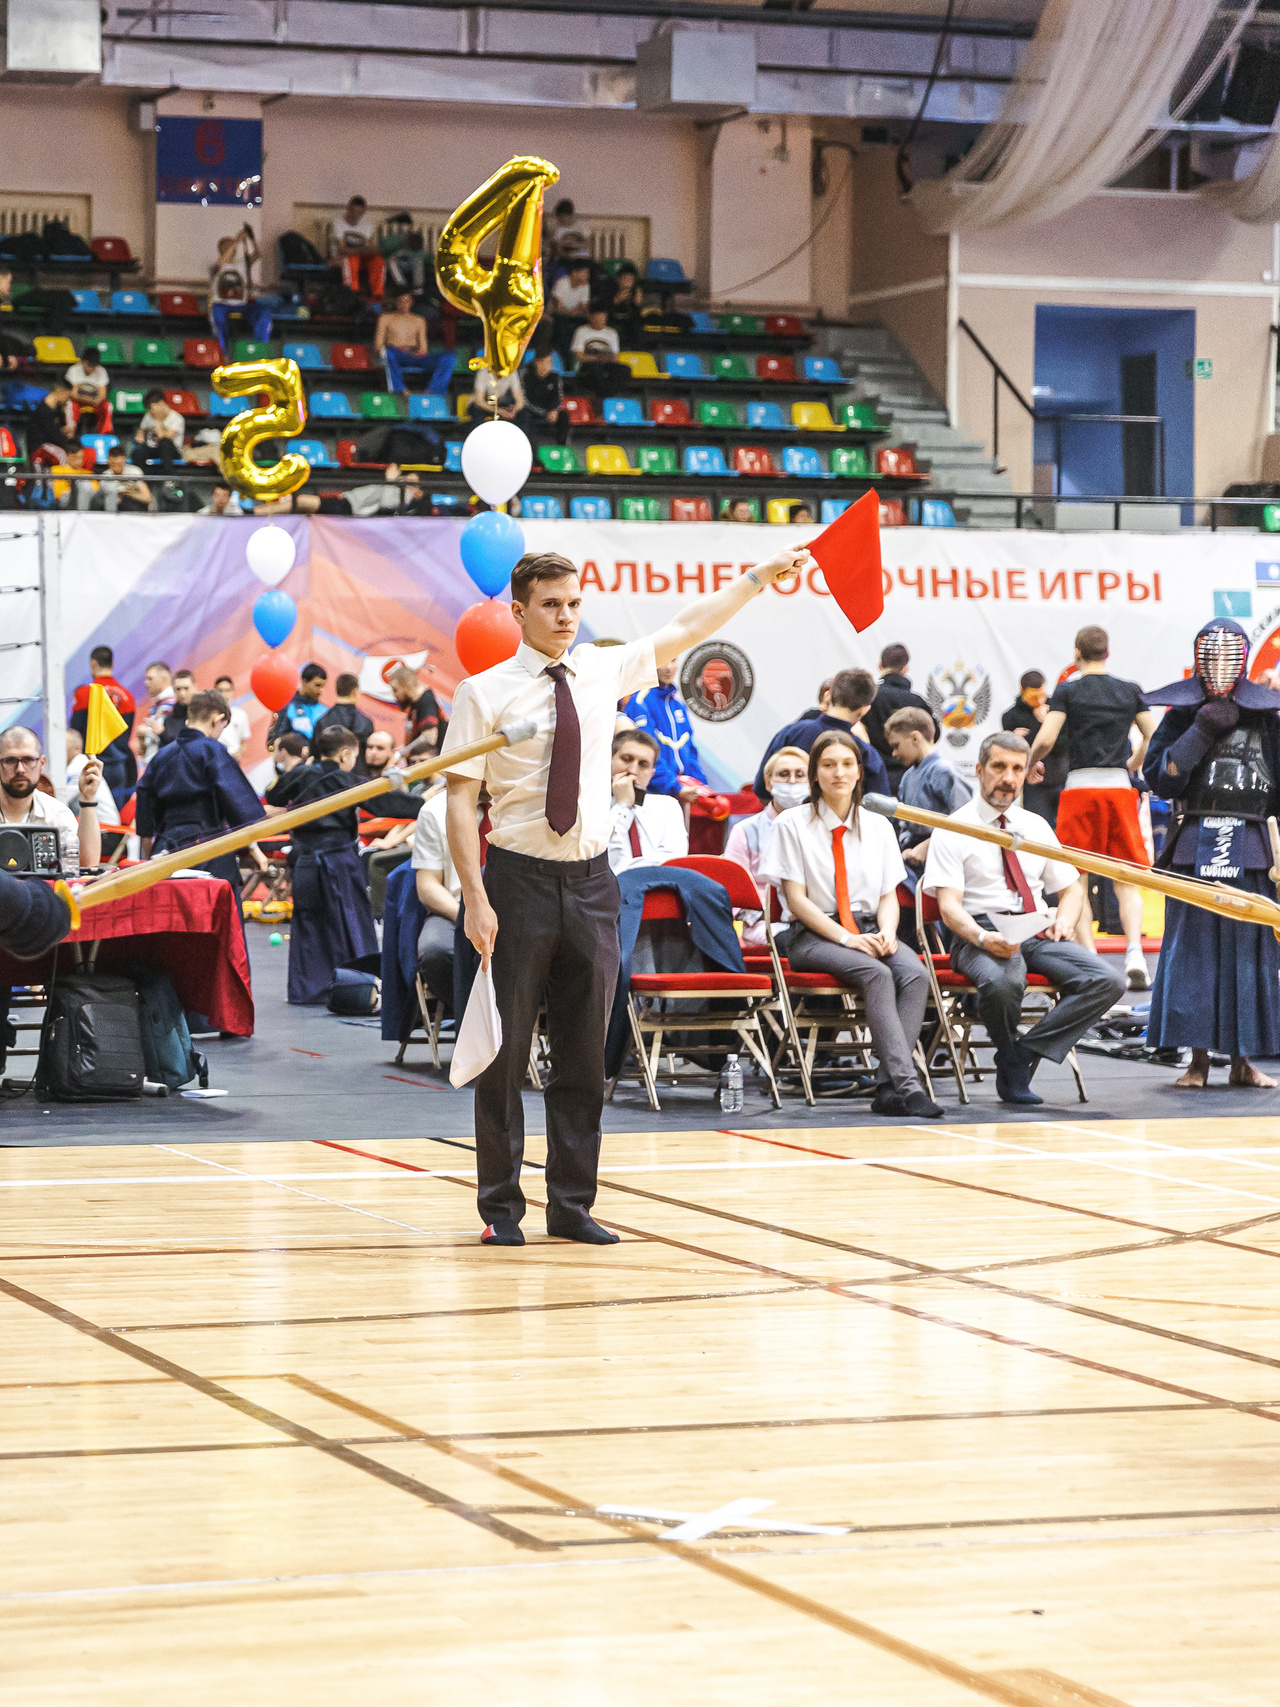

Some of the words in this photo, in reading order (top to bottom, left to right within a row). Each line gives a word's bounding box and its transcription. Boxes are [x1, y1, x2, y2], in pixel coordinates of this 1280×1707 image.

[194, 119, 227, 166] 6
[1039, 569, 1163, 602] ИГРЫ
[1199, 864, 1241, 878] KUDINOV
